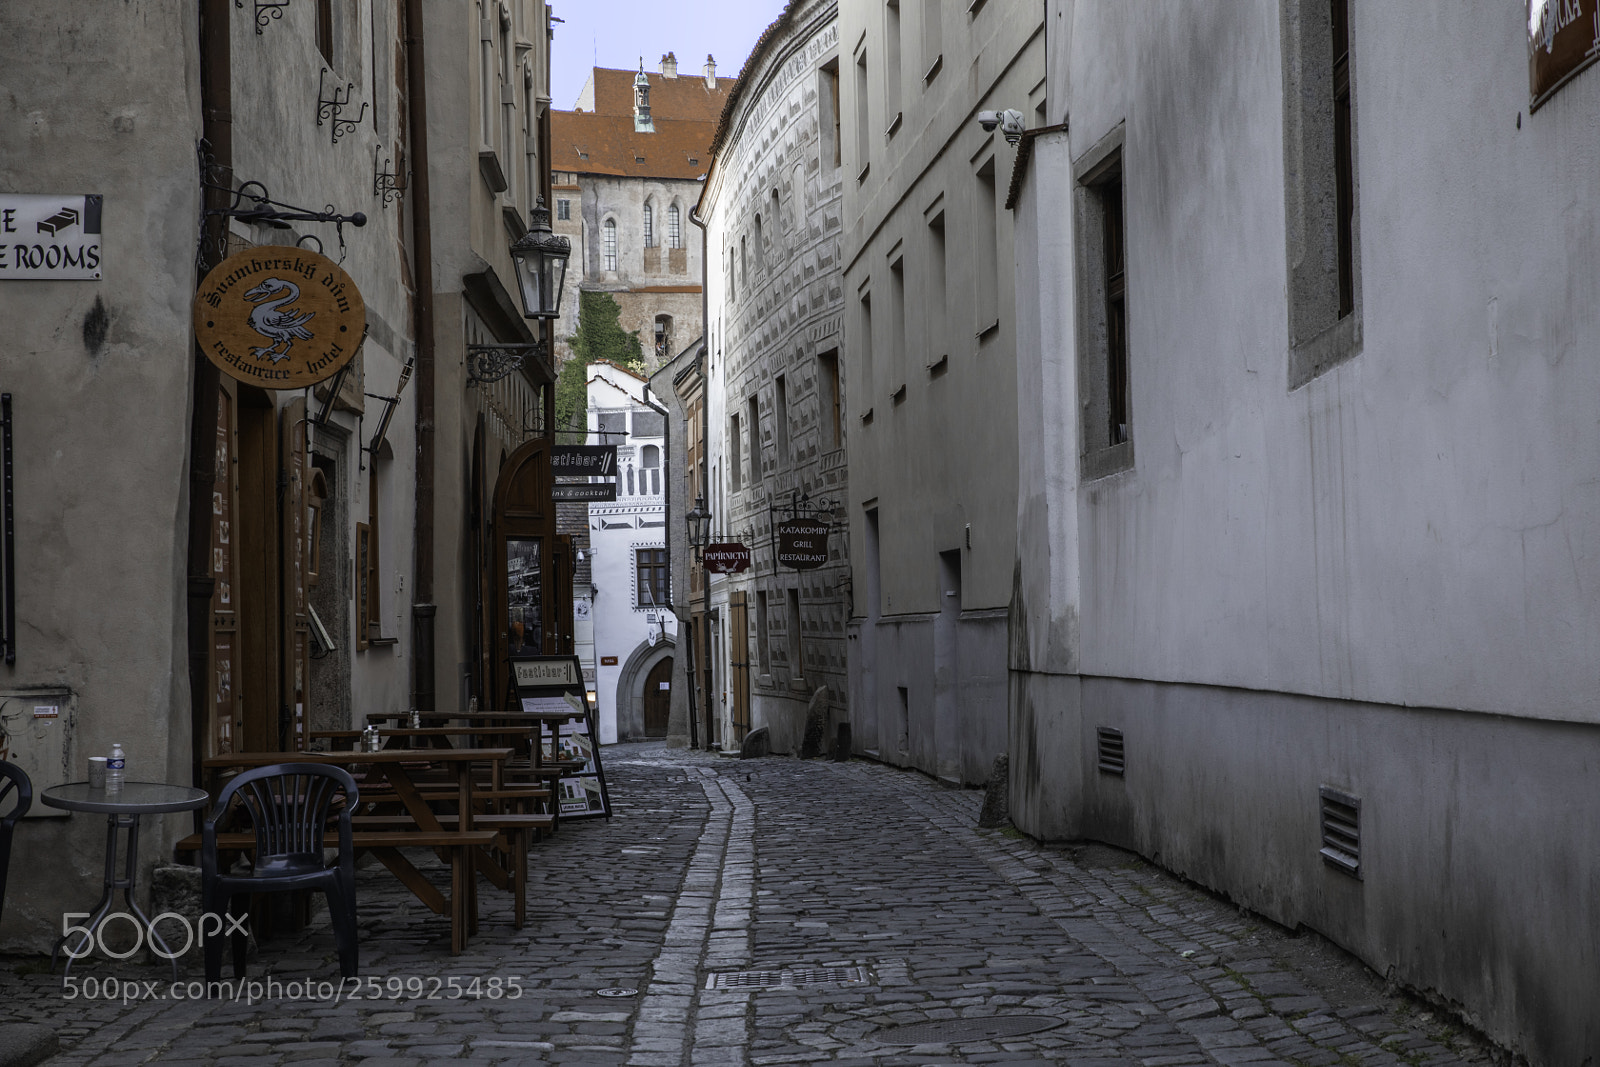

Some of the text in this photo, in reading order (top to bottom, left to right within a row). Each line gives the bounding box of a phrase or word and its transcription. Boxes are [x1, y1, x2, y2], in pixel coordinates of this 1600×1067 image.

[1, 208, 17, 232] E
[0, 244, 100, 269] E ROOMS
[202, 257, 350, 313] Švamberský dům
[213, 341, 290, 379] restaurace
[306, 342, 343, 375] hotel
[574, 488, 610, 497] cocktail
[780, 526, 828, 535] KATAKOMBY
[793, 540, 813, 549] GRILL
[705, 550, 749, 561] PAPÍRNICTVÍ
[779, 553, 827, 562] RESTAURANT
